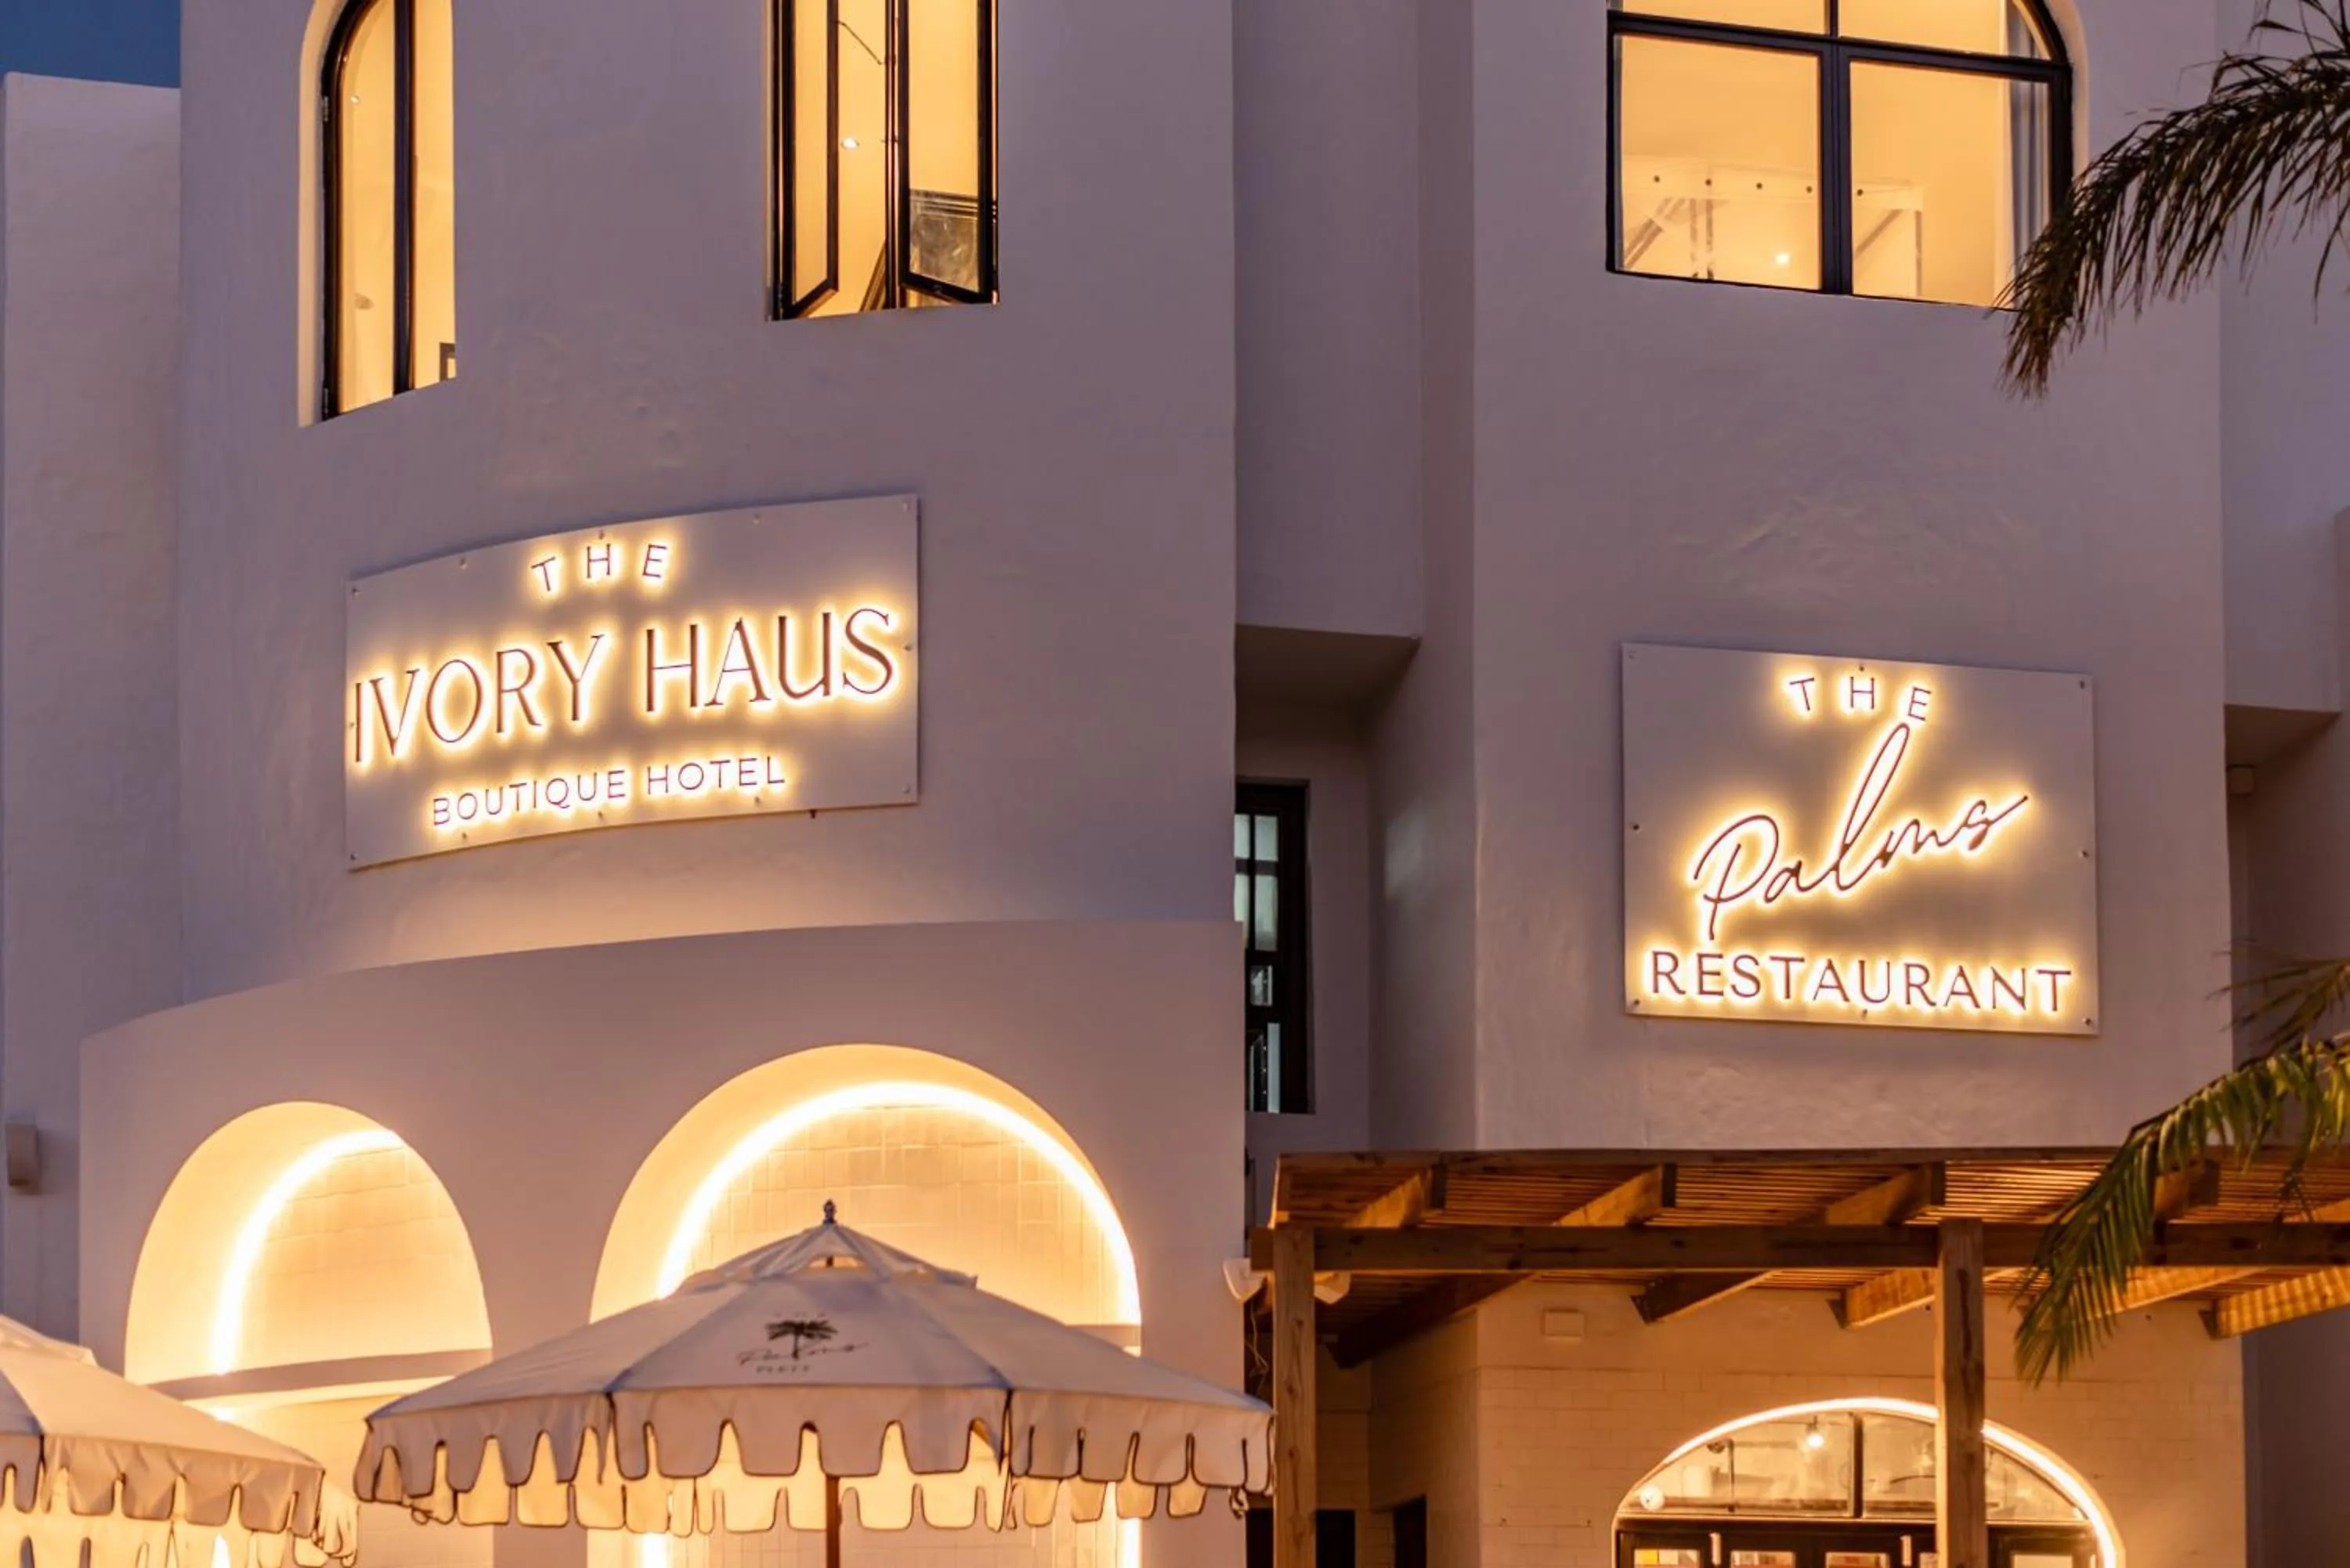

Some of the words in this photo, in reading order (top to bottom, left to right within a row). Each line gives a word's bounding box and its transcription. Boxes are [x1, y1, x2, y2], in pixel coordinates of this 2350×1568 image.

[531, 544, 668, 592] THE
[354, 633, 606, 764] IVORY
[645, 607, 895, 713] HAUS
[1789, 676, 1932, 721] THE
[432, 769, 627, 826] BOUTIQUE
[646, 755, 786, 796] HOTEL
[1693, 722, 2029, 941] Palms
[1650, 949, 2072, 1013] RESTAURANT
